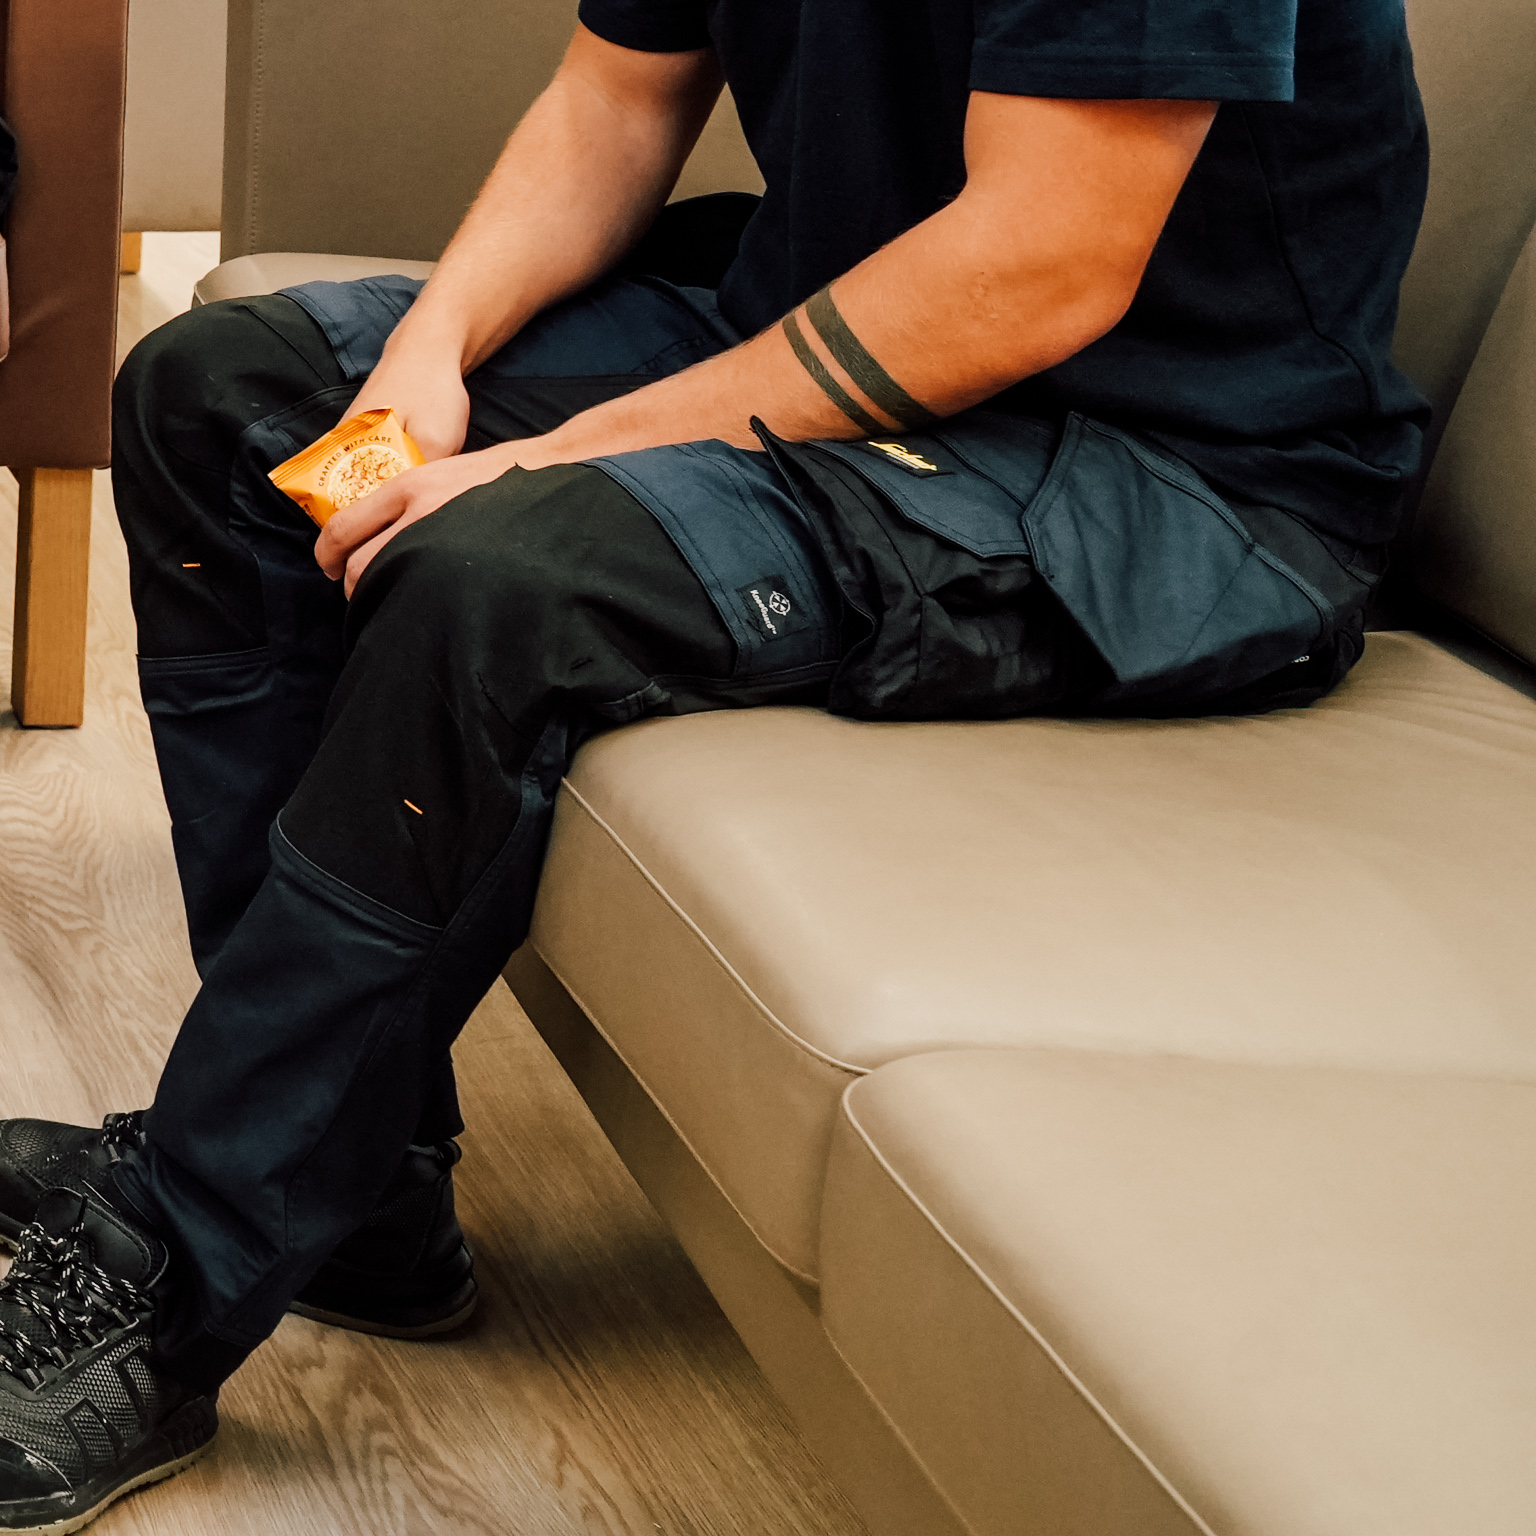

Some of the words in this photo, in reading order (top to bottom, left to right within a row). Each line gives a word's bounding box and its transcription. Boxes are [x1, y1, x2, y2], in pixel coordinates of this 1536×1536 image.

[318, 452, 342, 488] CRAFTED
[343, 438, 365, 453] WITH
[368, 435, 392, 444] CARE
